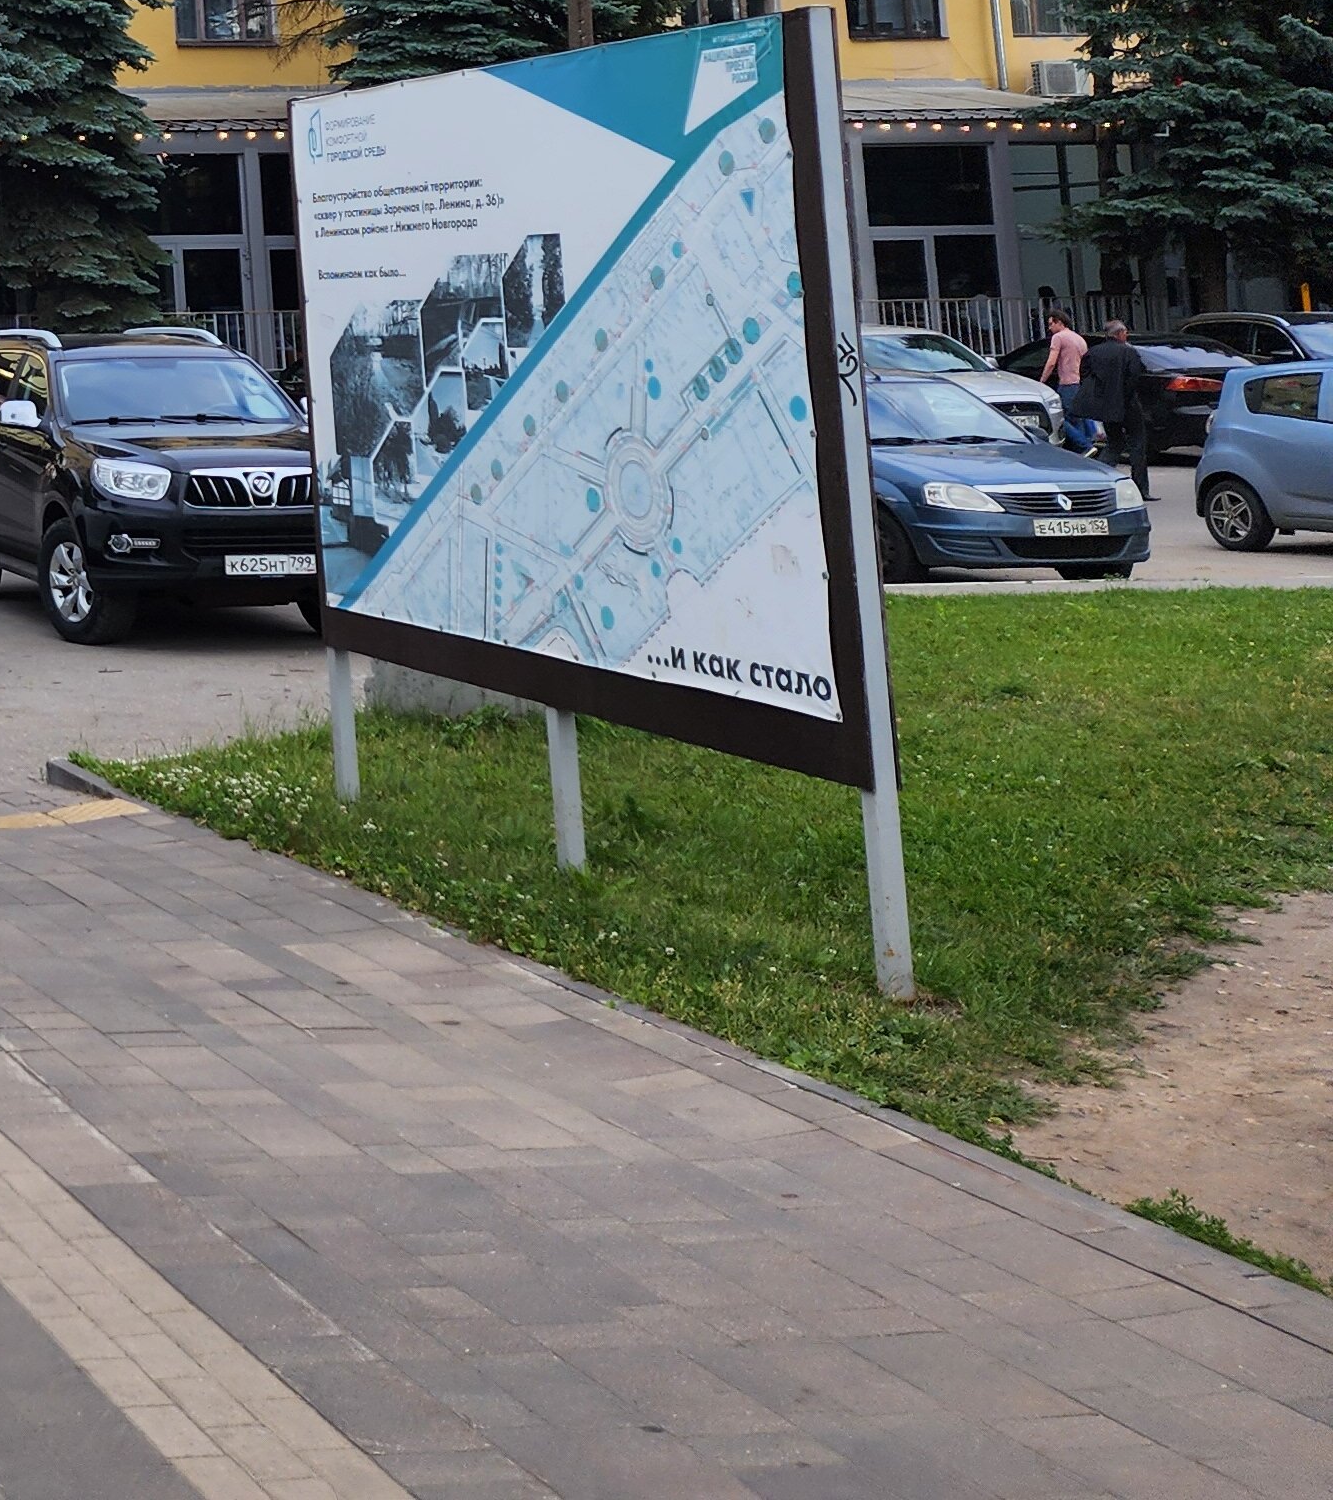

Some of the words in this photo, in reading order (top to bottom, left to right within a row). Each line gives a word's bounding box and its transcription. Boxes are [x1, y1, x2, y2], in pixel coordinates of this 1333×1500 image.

[312, 188, 372, 203] Благоустройство
[373, 180, 429, 197] общественной
[430, 178, 483, 194] территории:
[344, 206, 383, 219] гостиницы
[383, 203, 420, 217] Заречная
[439, 197, 474, 211] Ленина,
[320, 226, 360, 238] Ленинском
[361, 223, 389, 238] районе
[431, 217, 478, 231] Новгорода
[318, 269, 363, 280] Вспоминаем
[364, 268, 378, 278] как
[230, 558, 286, 572] К625НТ
[290, 556, 312, 568] 799
[647, 645, 686, 671] ...и
[692, 650, 744, 683] как
[749, 661, 832, 701] стало
